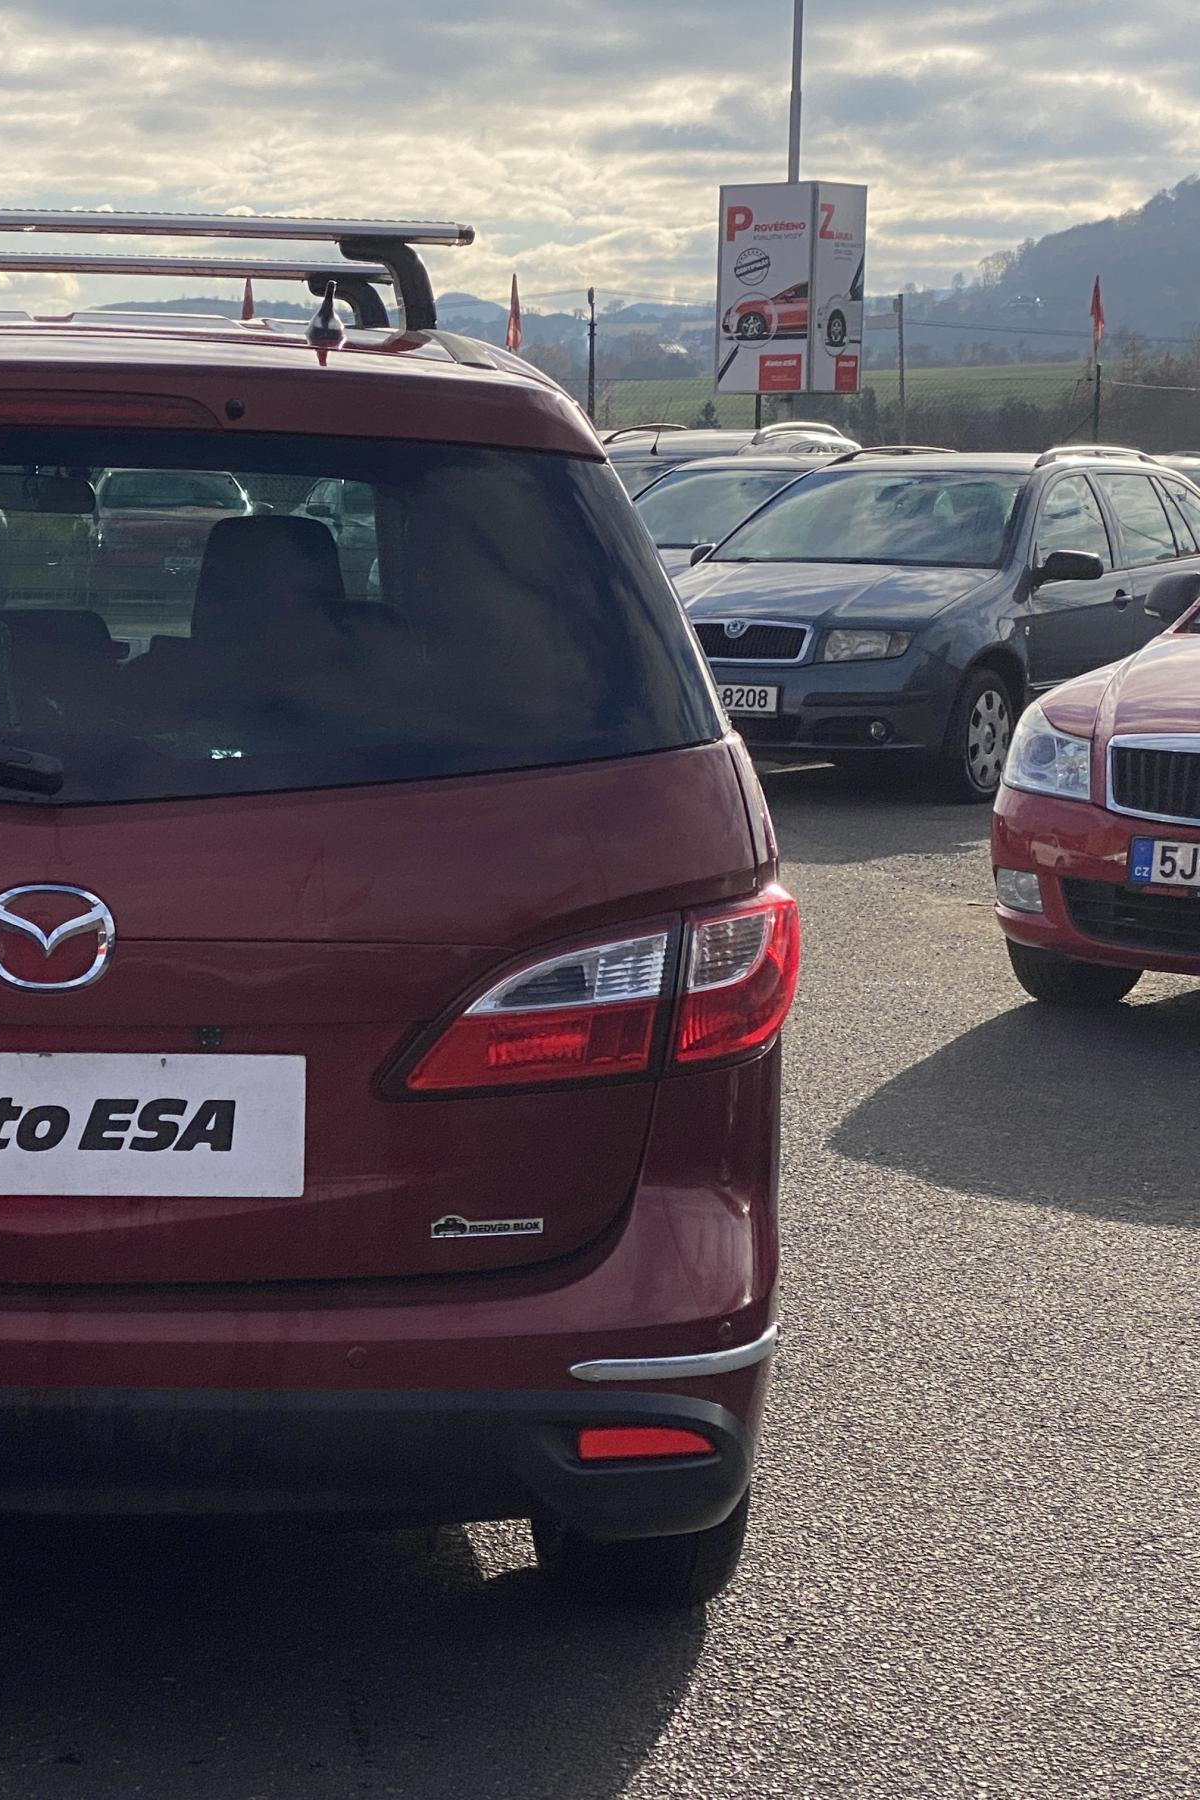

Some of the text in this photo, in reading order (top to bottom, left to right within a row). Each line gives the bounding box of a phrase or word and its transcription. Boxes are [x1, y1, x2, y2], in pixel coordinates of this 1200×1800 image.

[722, 687, 768, 708] 8208
[1134, 866, 1150, 877] CZ
[1160, 845, 1199, 880] 5J
[77, 1098, 236, 1152] ESA
[513, 1221, 540, 1231] BLOK
